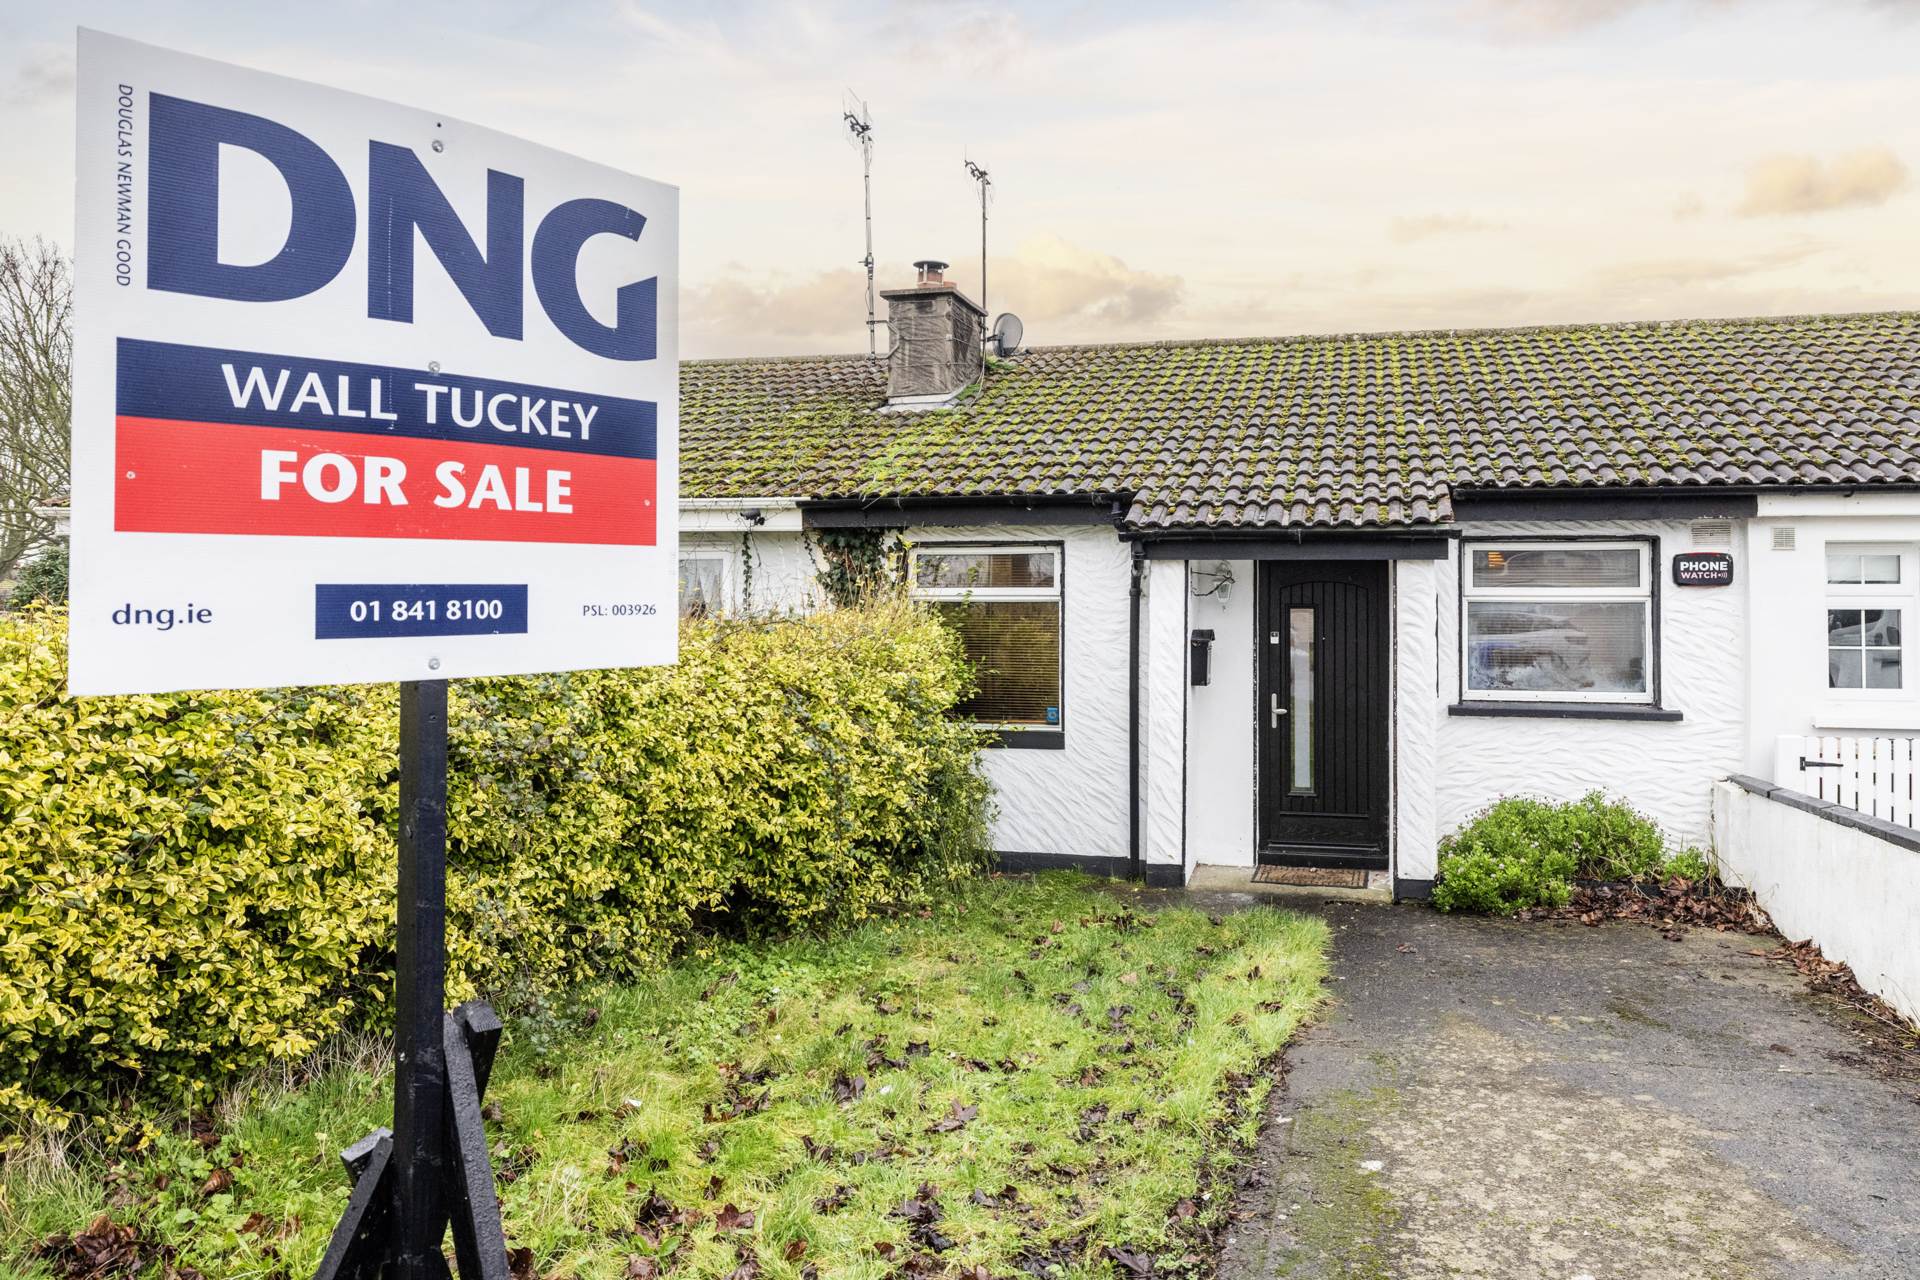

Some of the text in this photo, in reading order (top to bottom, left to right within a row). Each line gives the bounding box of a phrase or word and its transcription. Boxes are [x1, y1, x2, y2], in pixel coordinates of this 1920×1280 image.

[116, 83, 134, 287] DOUGLAS NEWMAN GOOD
[147, 91, 658, 362] DNG
[221, 363, 600, 440] WALL TUCKEY
[260, 449, 574, 514] FOR SALE
[1680, 561, 1728, 571] PHONE
[1680, 571, 1718, 579] WATCH
[111, 602, 213, 631] dng.ie
[350, 599, 503, 622] 01 841 8100
[582, 603, 657, 617] PSL: 003926
